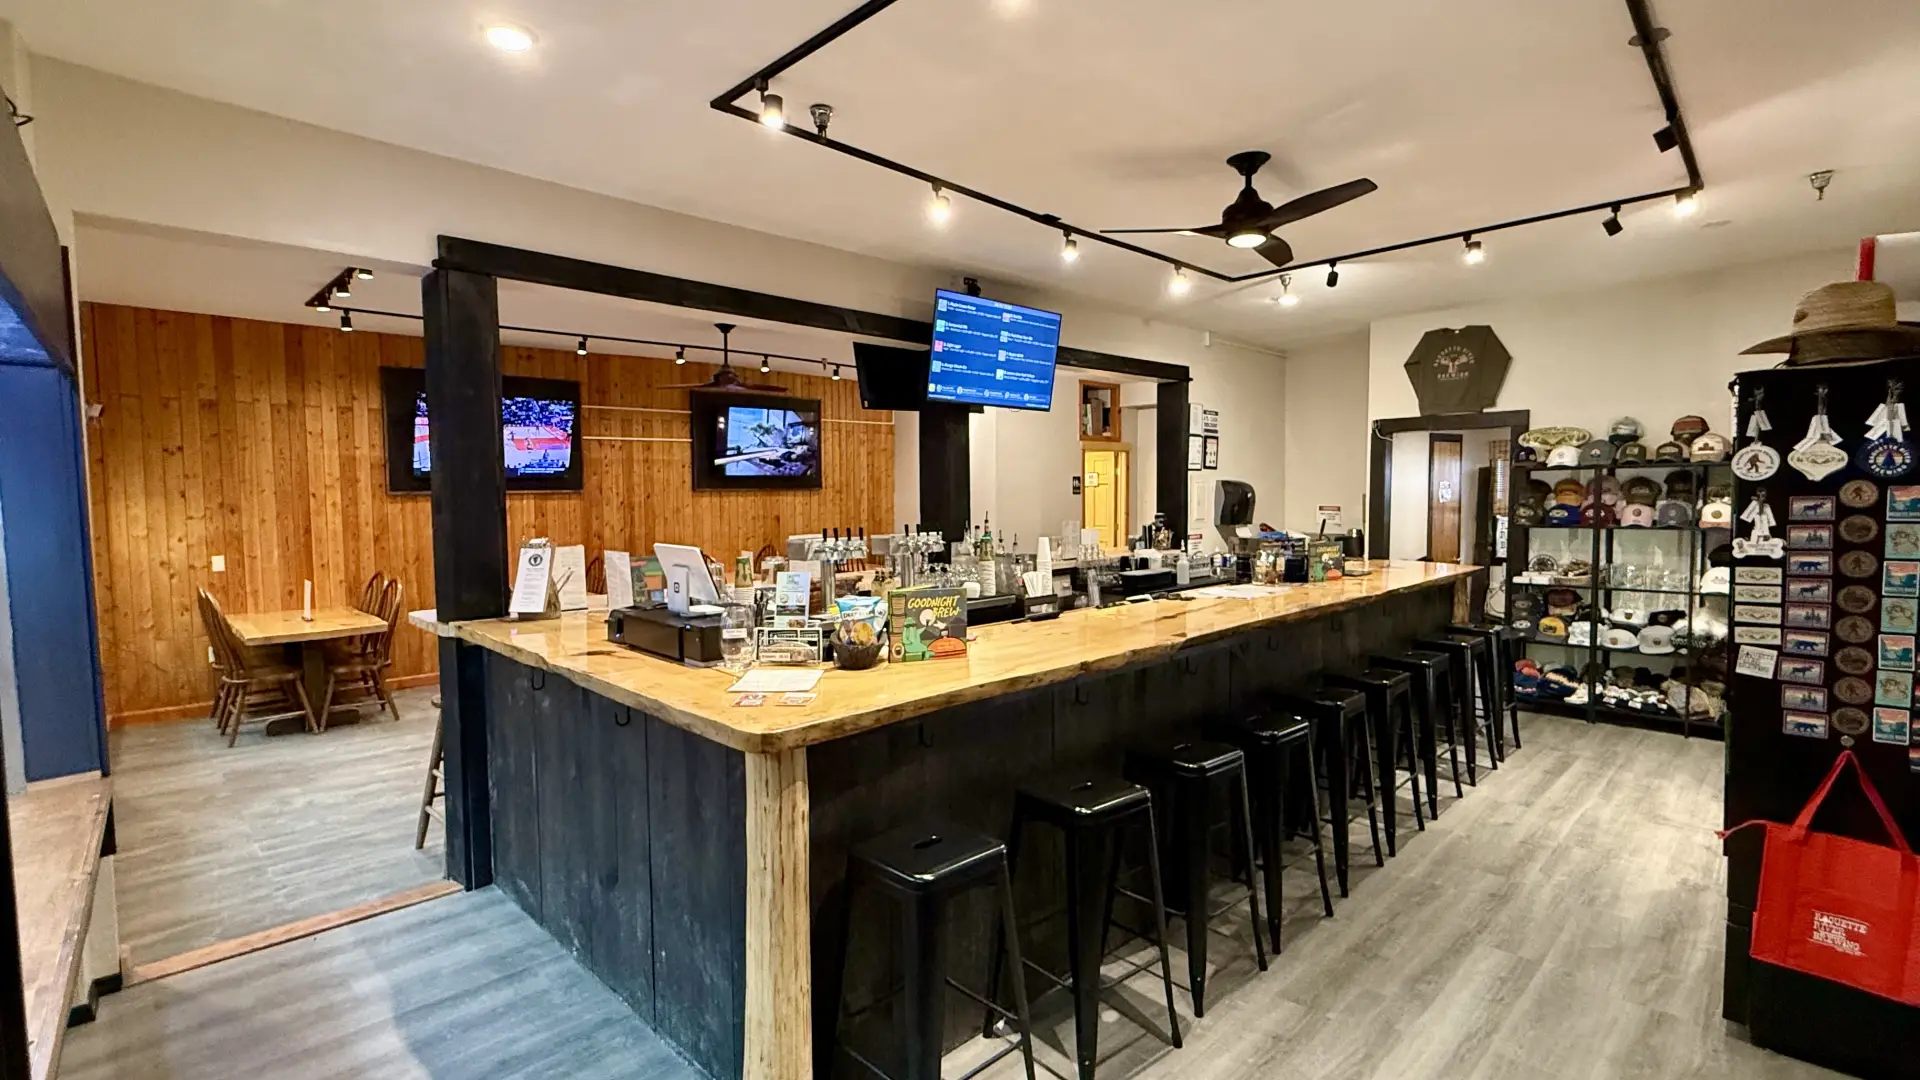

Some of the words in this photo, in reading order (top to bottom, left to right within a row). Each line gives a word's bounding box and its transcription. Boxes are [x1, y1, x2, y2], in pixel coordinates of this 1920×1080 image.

[1870, 464, 1908, 476] BREWING
[907, 595, 960, 609] GOODNIGHT
[932, 606, 962, 618] BREW
[1813, 921, 1846, 937] RIVER
[1814, 911, 1869, 935] RAQUETTE
[1812, 930, 1861, 951] BREWING
